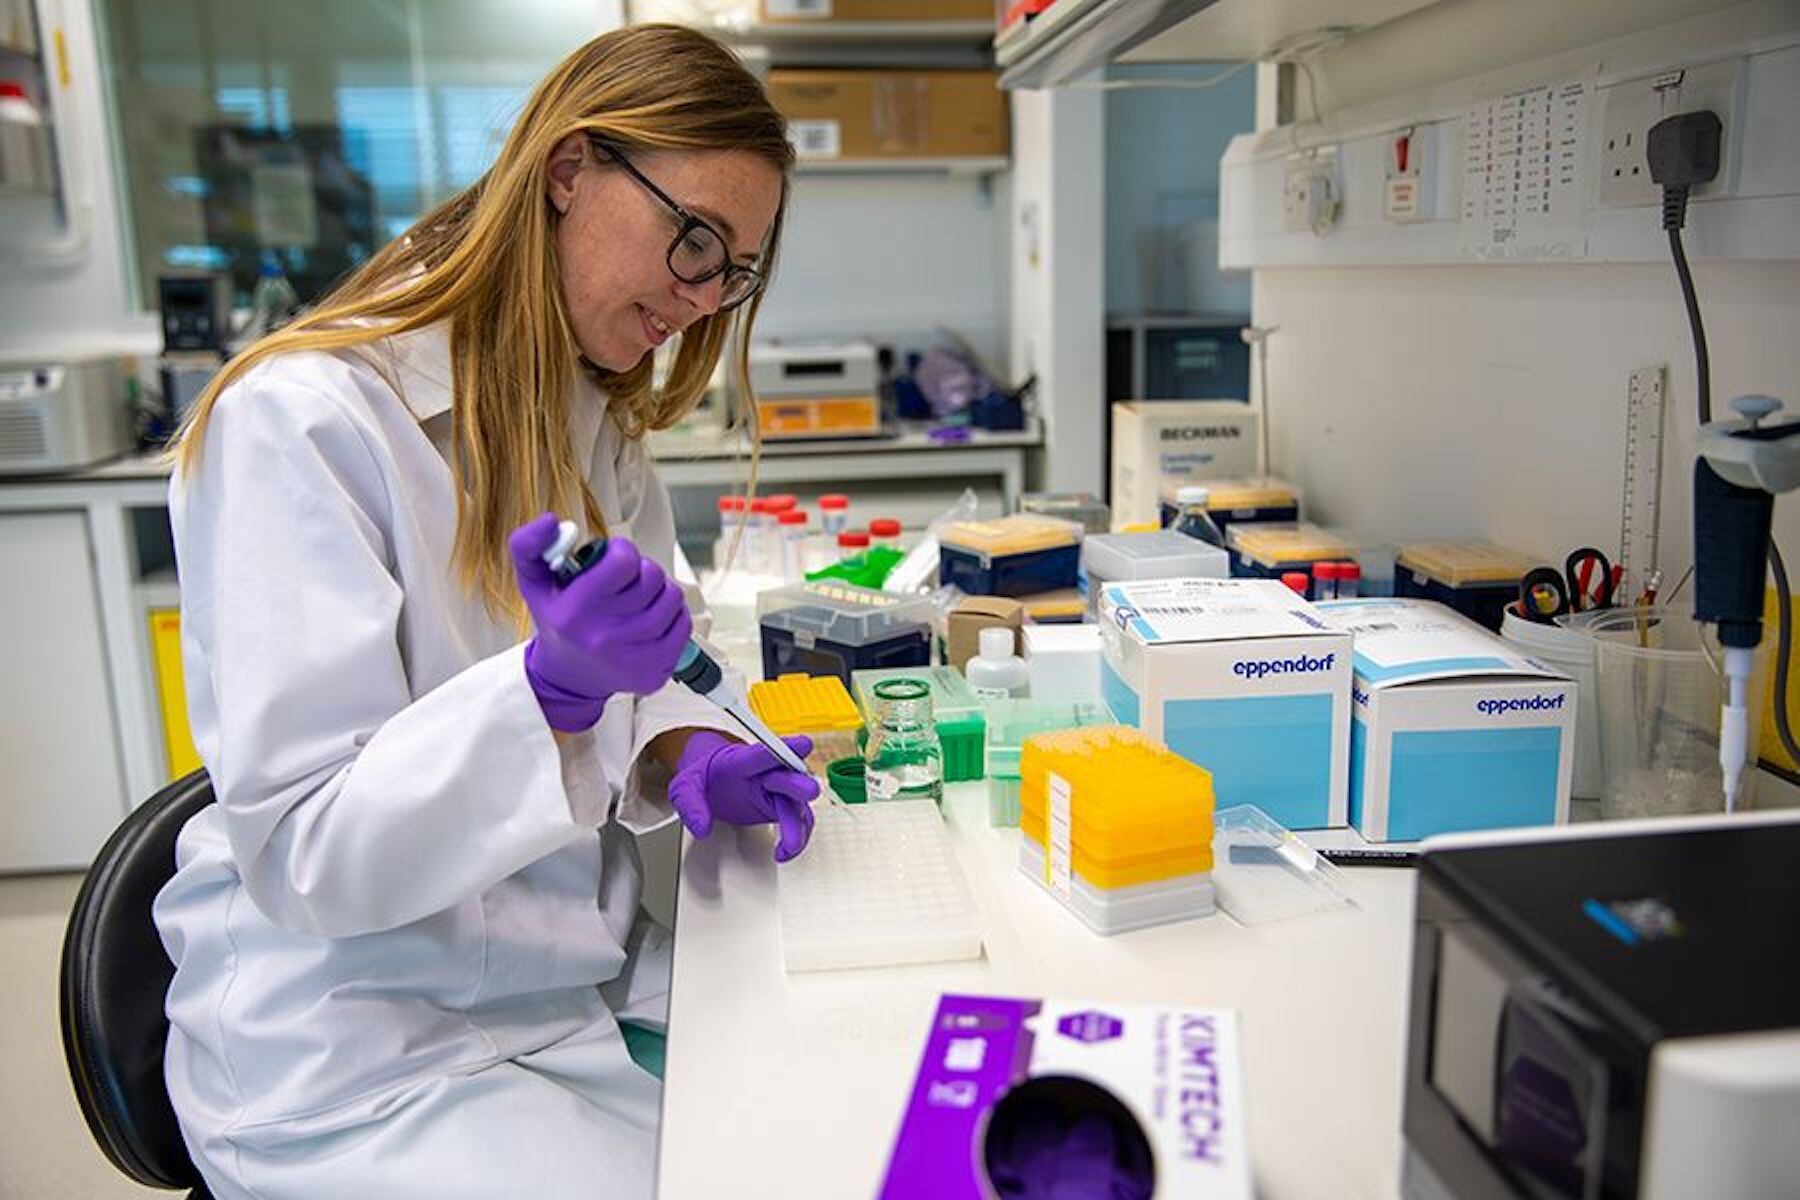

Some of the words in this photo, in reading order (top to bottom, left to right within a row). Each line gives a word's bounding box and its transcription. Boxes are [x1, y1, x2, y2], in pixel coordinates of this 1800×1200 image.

[1160, 426, 1241, 441] BECKMAN
[1233, 653, 1334, 678] eppendorf
[1477, 694, 1565, 714] eppendorf
[1180, 1013, 1223, 1166] KIMTECH
